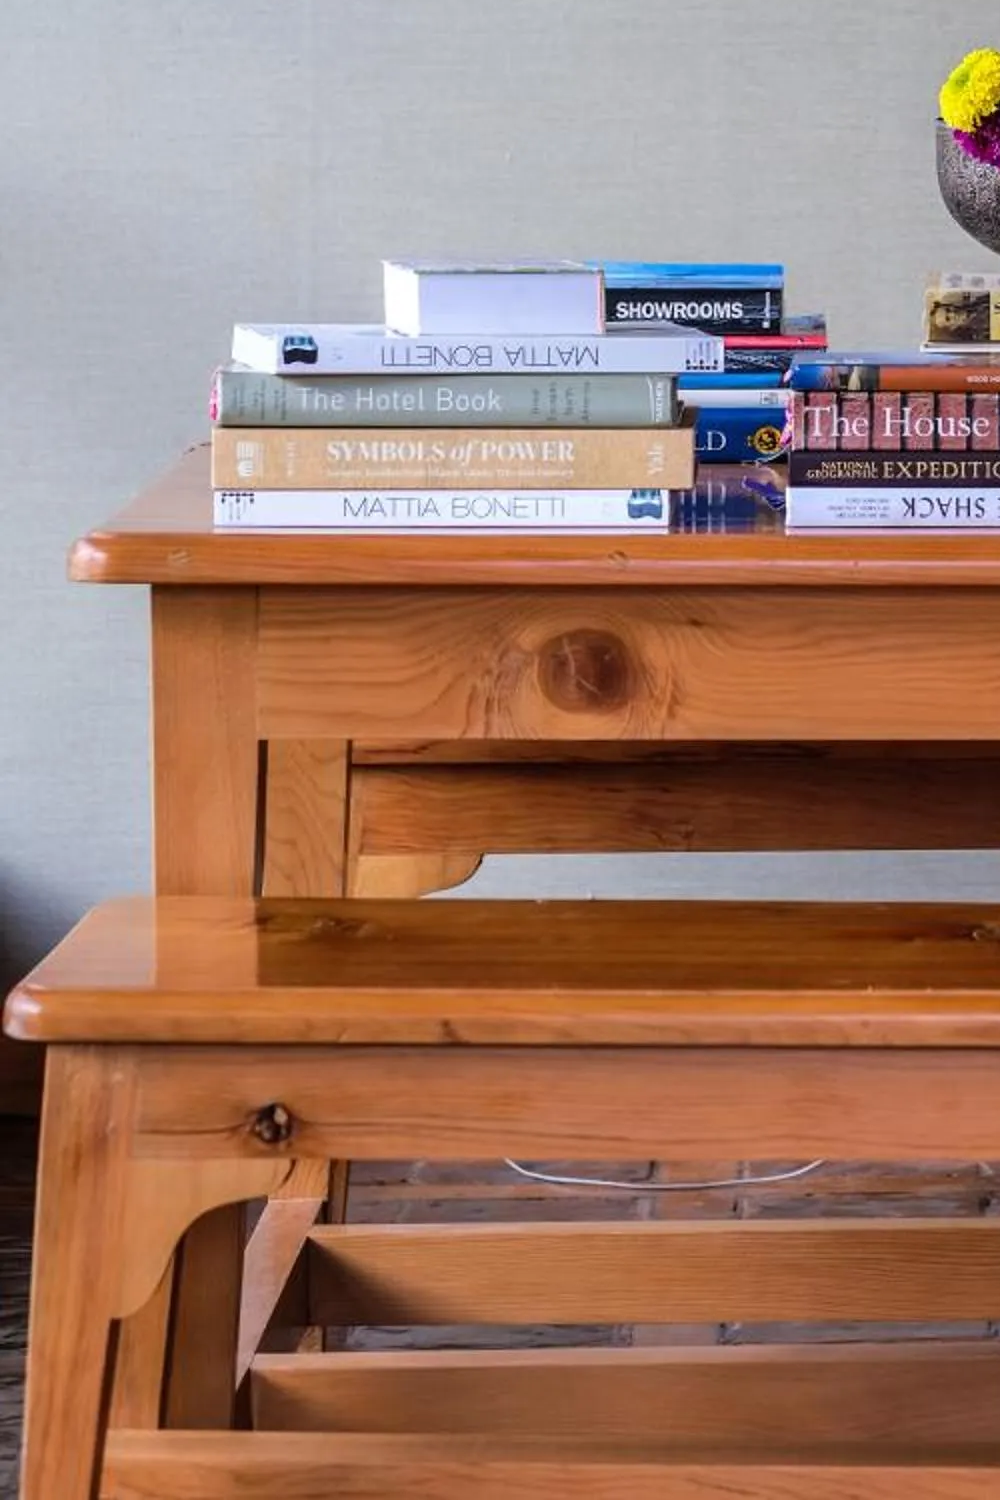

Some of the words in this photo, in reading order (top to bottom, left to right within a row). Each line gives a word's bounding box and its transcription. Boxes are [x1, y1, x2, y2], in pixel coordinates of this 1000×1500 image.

[615, 301, 743, 320] SHOWROOMS
[380, 345, 493, 367] BONETTI
[503, 345, 600, 367] MATTIA
[296, 387, 346, 411] The
[355, 387, 424, 411] Hotel
[436, 387, 501, 411] Book
[803, 403, 869, 438] The
[881, 407, 990, 438] House
[327, 440, 446, 463] SYMBOLS
[449, 440, 476, 466] of
[481, 440, 575, 463] POWER
[820, 461, 876, 470] NATIONAL
[342, 496, 441, 518] MATTIA
[451, 496, 566, 519] BONETTI
[901, 496, 985, 518] SHACK
